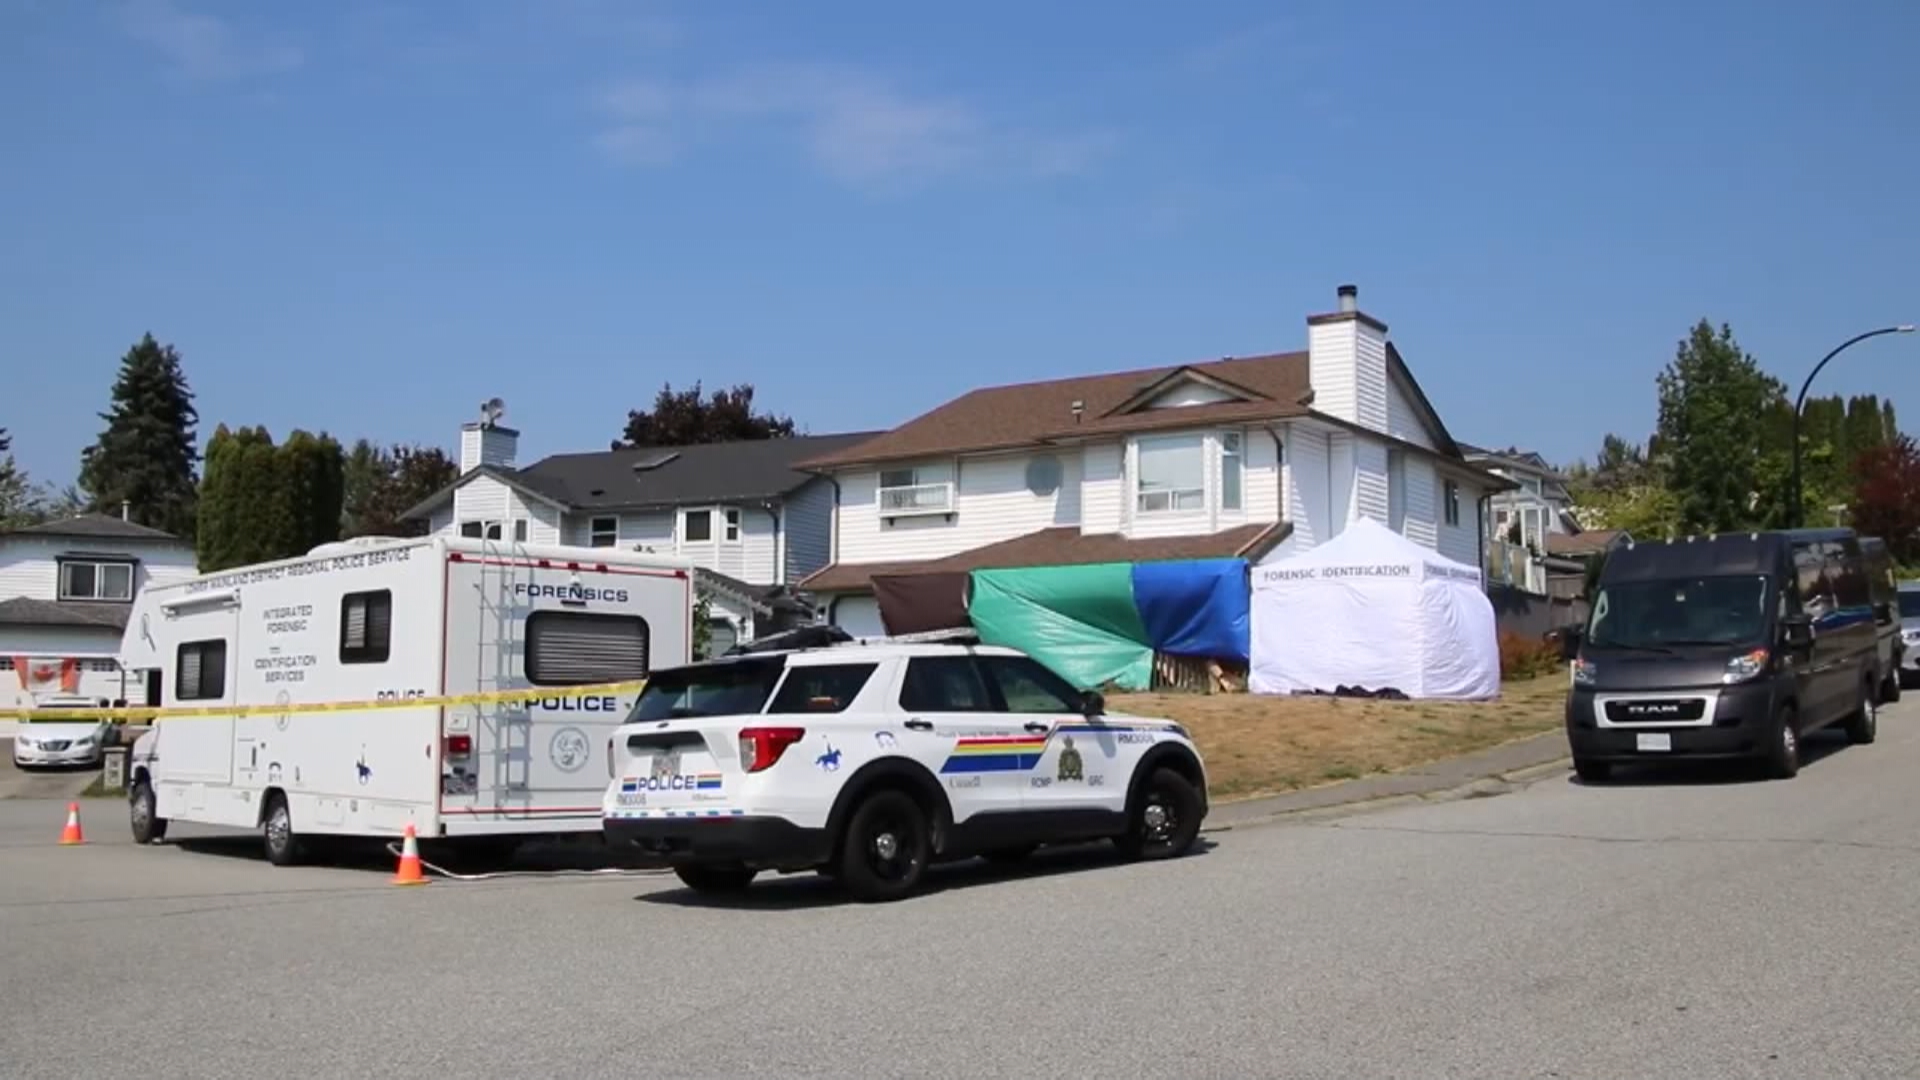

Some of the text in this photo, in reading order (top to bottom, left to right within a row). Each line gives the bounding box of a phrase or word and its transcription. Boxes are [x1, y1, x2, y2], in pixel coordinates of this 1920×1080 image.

[287, 559, 330, 577] REGIONAL
[332, 554, 365, 571] POLICE
[367, 547, 411, 567] SERVICE
[1264, 568, 1316, 582] FORENSIC
[1322, 564, 1411, 577] IDENTIFICATION
[515, 583, 629, 602] FORENSICS
[263, 604, 313, 620] INTEGRATED
[266, 619, 307, 633] FORENSIC
[254, 654, 317, 669] IDENTIFICATION
[265, 670, 305, 683] SERVICES
[525, 695, 617, 712] POLICE
[1627, 704, 1679, 714] RAM
[638, 774, 696, 791] POLICE
[1031, 777, 1052, 788] RCMP
